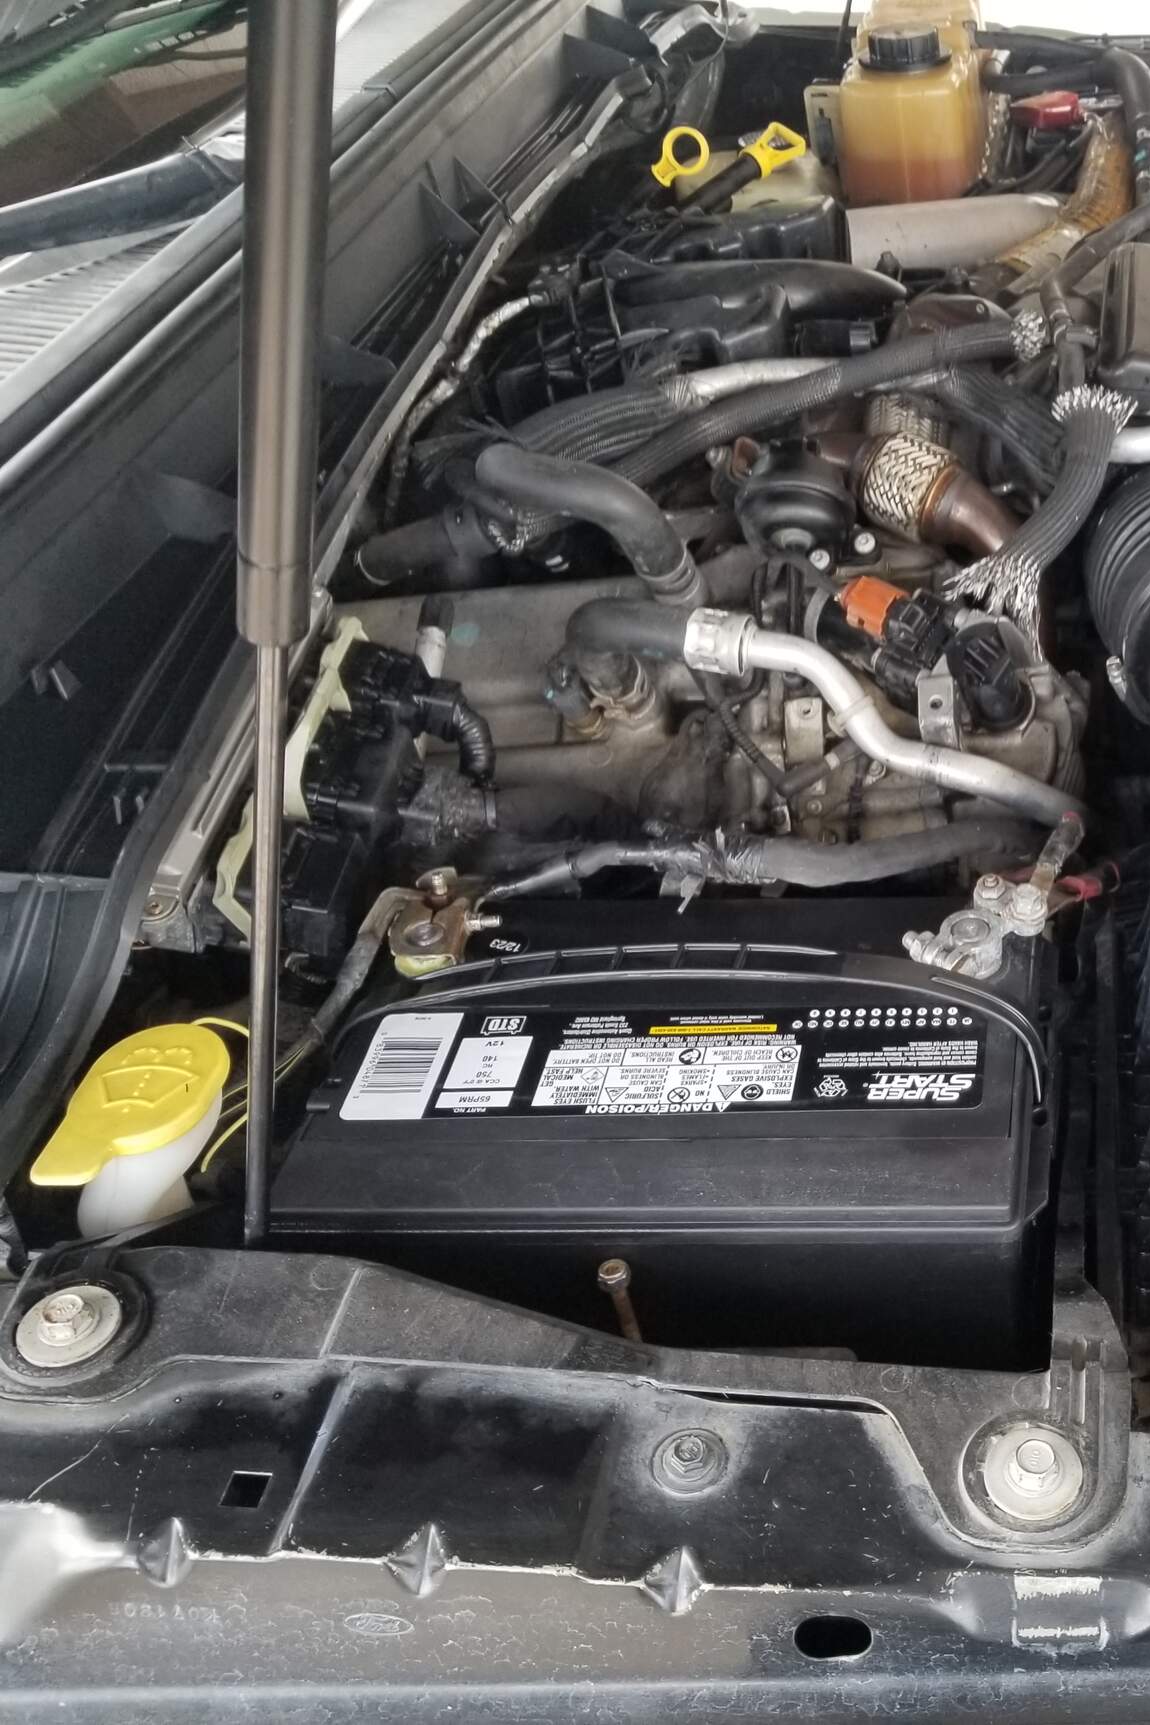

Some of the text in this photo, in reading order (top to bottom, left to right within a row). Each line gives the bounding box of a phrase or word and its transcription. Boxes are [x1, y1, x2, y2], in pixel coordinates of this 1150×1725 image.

[488, 1018, 520, 1031] STD
[869, 1074, 976, 1090] START
[867, 1088, 962, 1102] SUPER
[585, 1102, 714, 1114] DANGER/POISON
